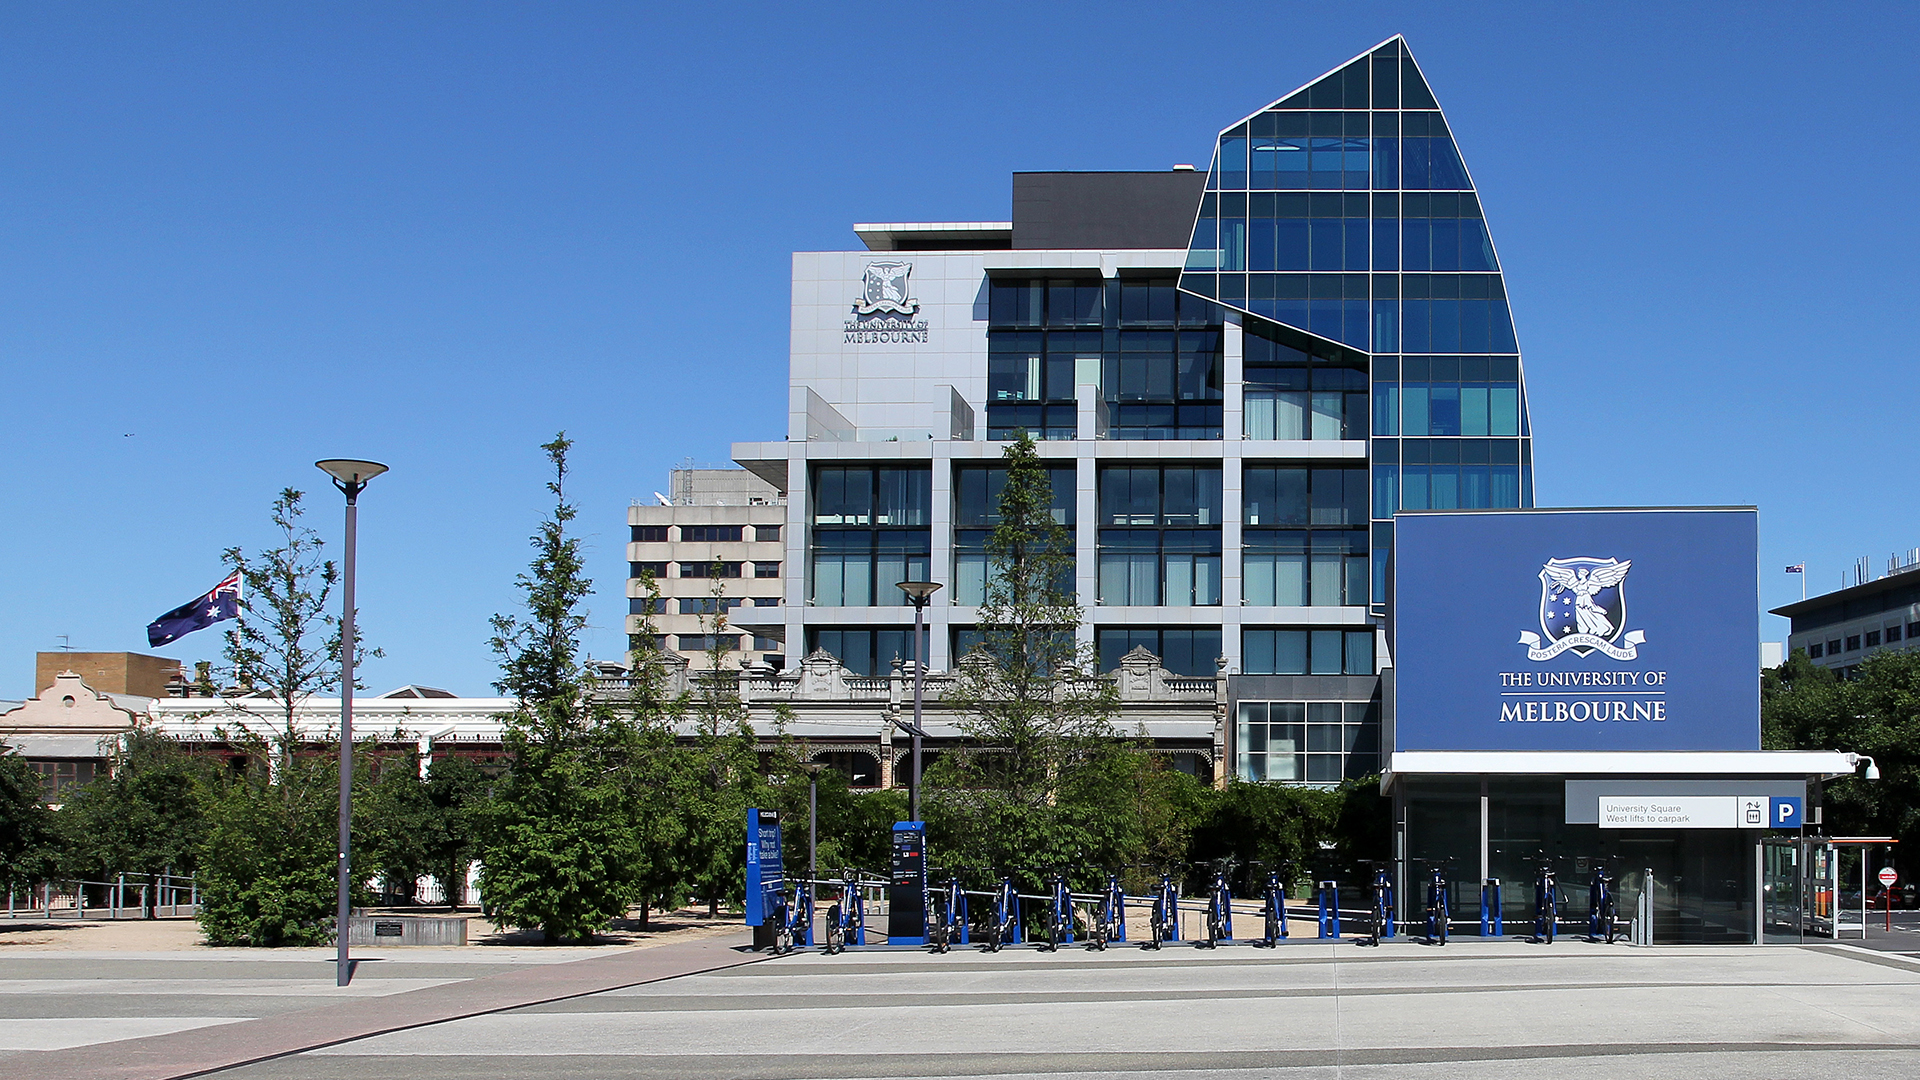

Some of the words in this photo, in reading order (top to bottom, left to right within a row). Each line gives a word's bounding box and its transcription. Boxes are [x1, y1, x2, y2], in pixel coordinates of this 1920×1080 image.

[844, 320, 863, 329] THE
[864, 320, 914, 329] UNIVERSITY
[917, 320, 929, 329] OF
[844, 331, 929, 344] MELBOURNE
[1530, 642, 1568, 658] POSTERA
[1568, 636, 1607, 650] CRESCAM
[1607, 645, 1634, 658] LAUDE
[1498, 672, 1532, 687] THE
[1536, 671, 1640, 687] UNIVERSITY
[1644, 671, 1667, 686] OF
[1498, 700, 1667, 722] MELBOURNE
[1606, 804, 1648, 815] University
[1650, 804, 1682, 814] Square
[1778, 803, 1794, 823] P
[1606, 815, 1628, 823] West
[1629, 814, 1646, 823] lifts
[1647, 815, 1656, 823] to
[1657, 814, 1691, 824] carpark
